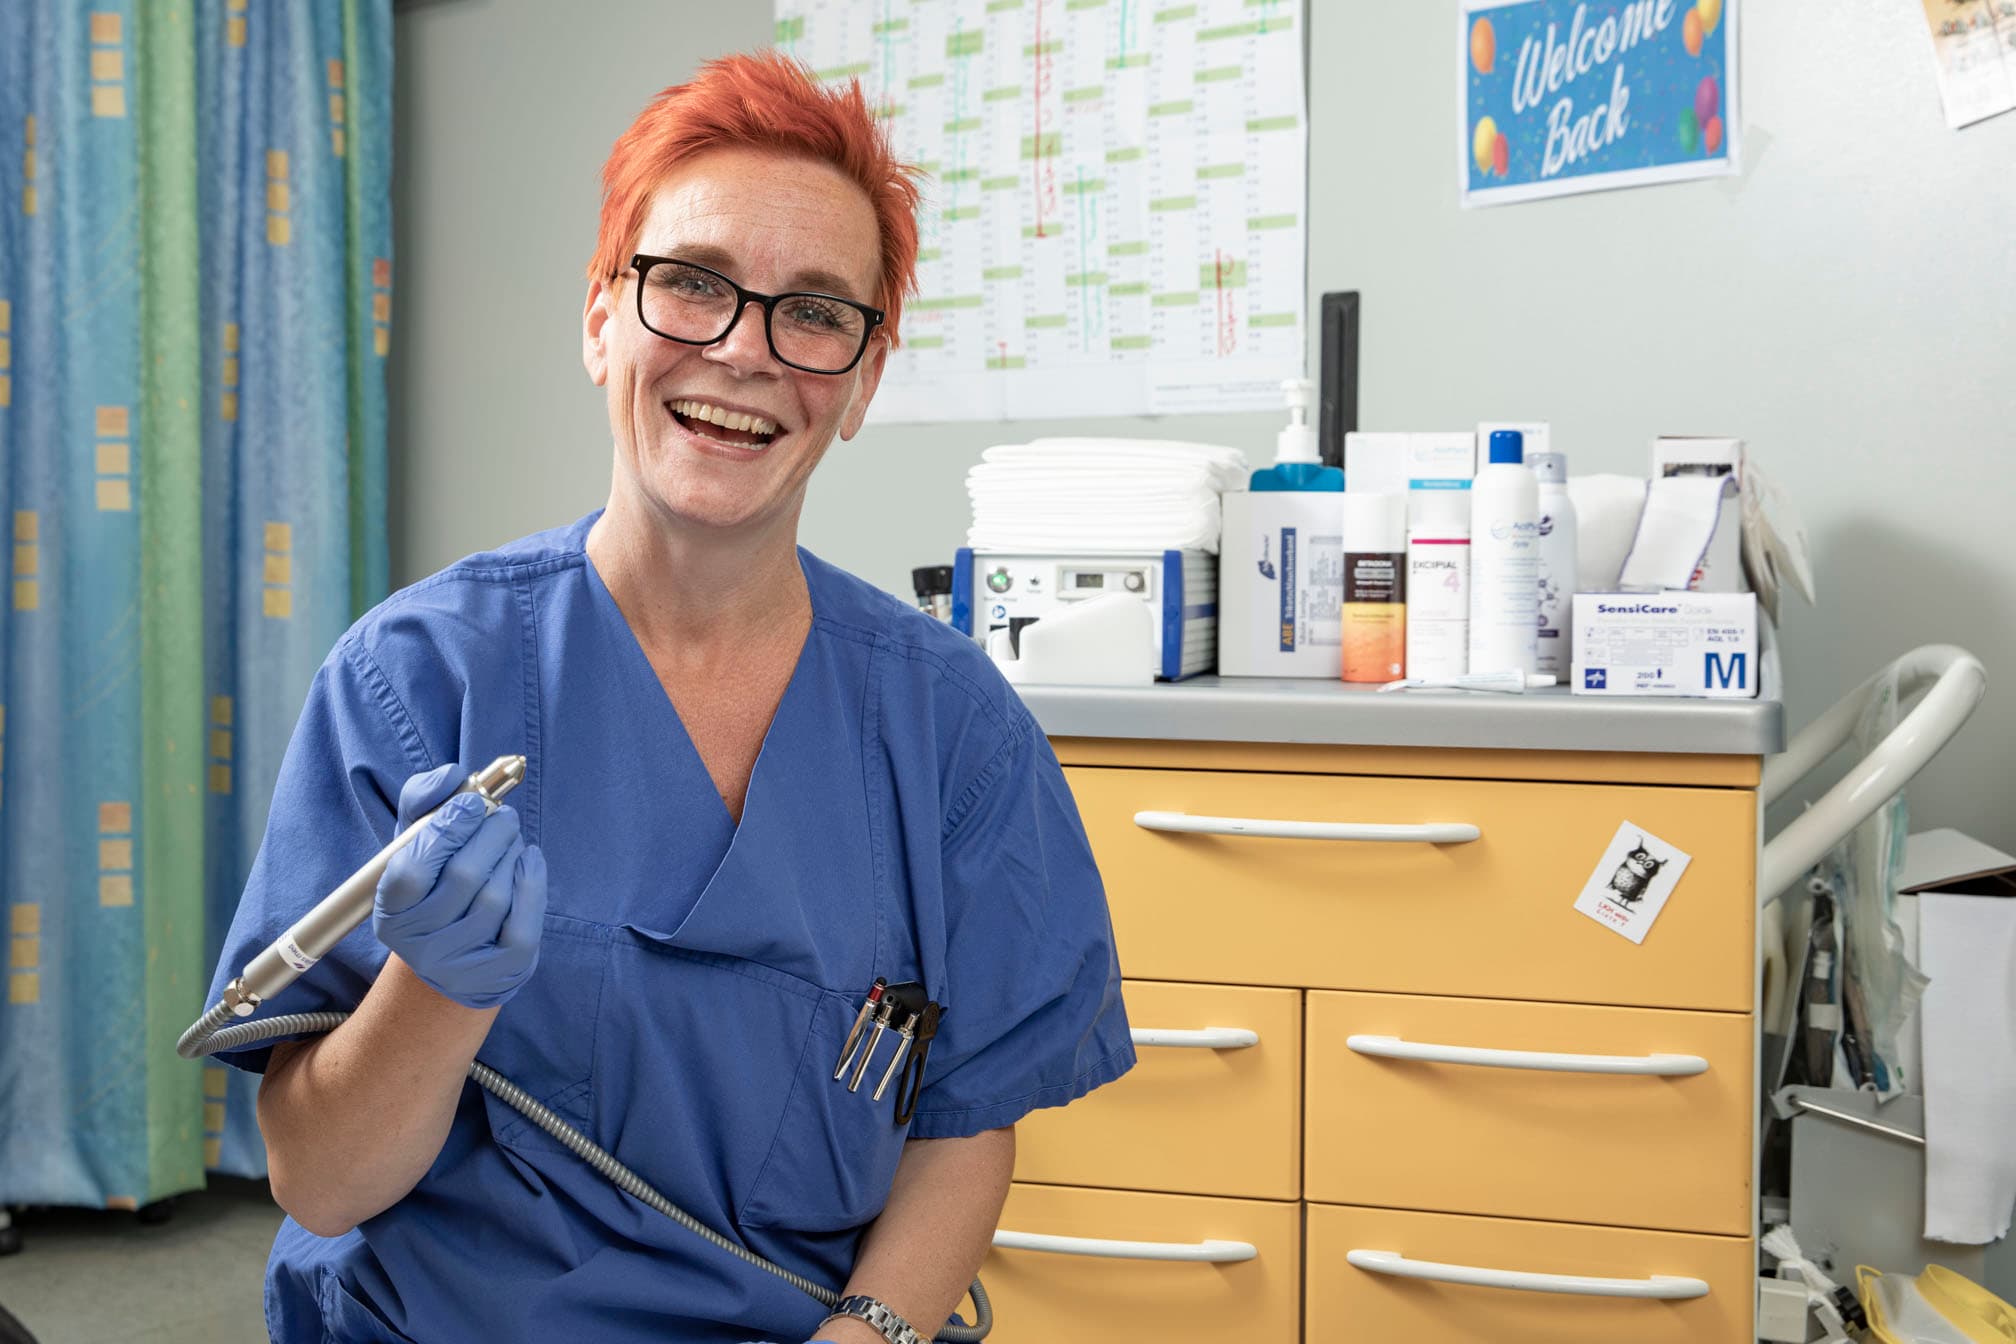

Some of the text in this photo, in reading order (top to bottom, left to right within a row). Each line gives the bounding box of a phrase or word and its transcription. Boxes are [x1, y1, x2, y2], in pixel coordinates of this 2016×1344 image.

[1512, 0, 1678, 114] Welcome
[1541, 64, 1631, 178] Back
[1597, 603, 1678, 615] SensiCare
[1282, 623, 1294, 646] ABE
[1704, 652, 1747, 689] M
